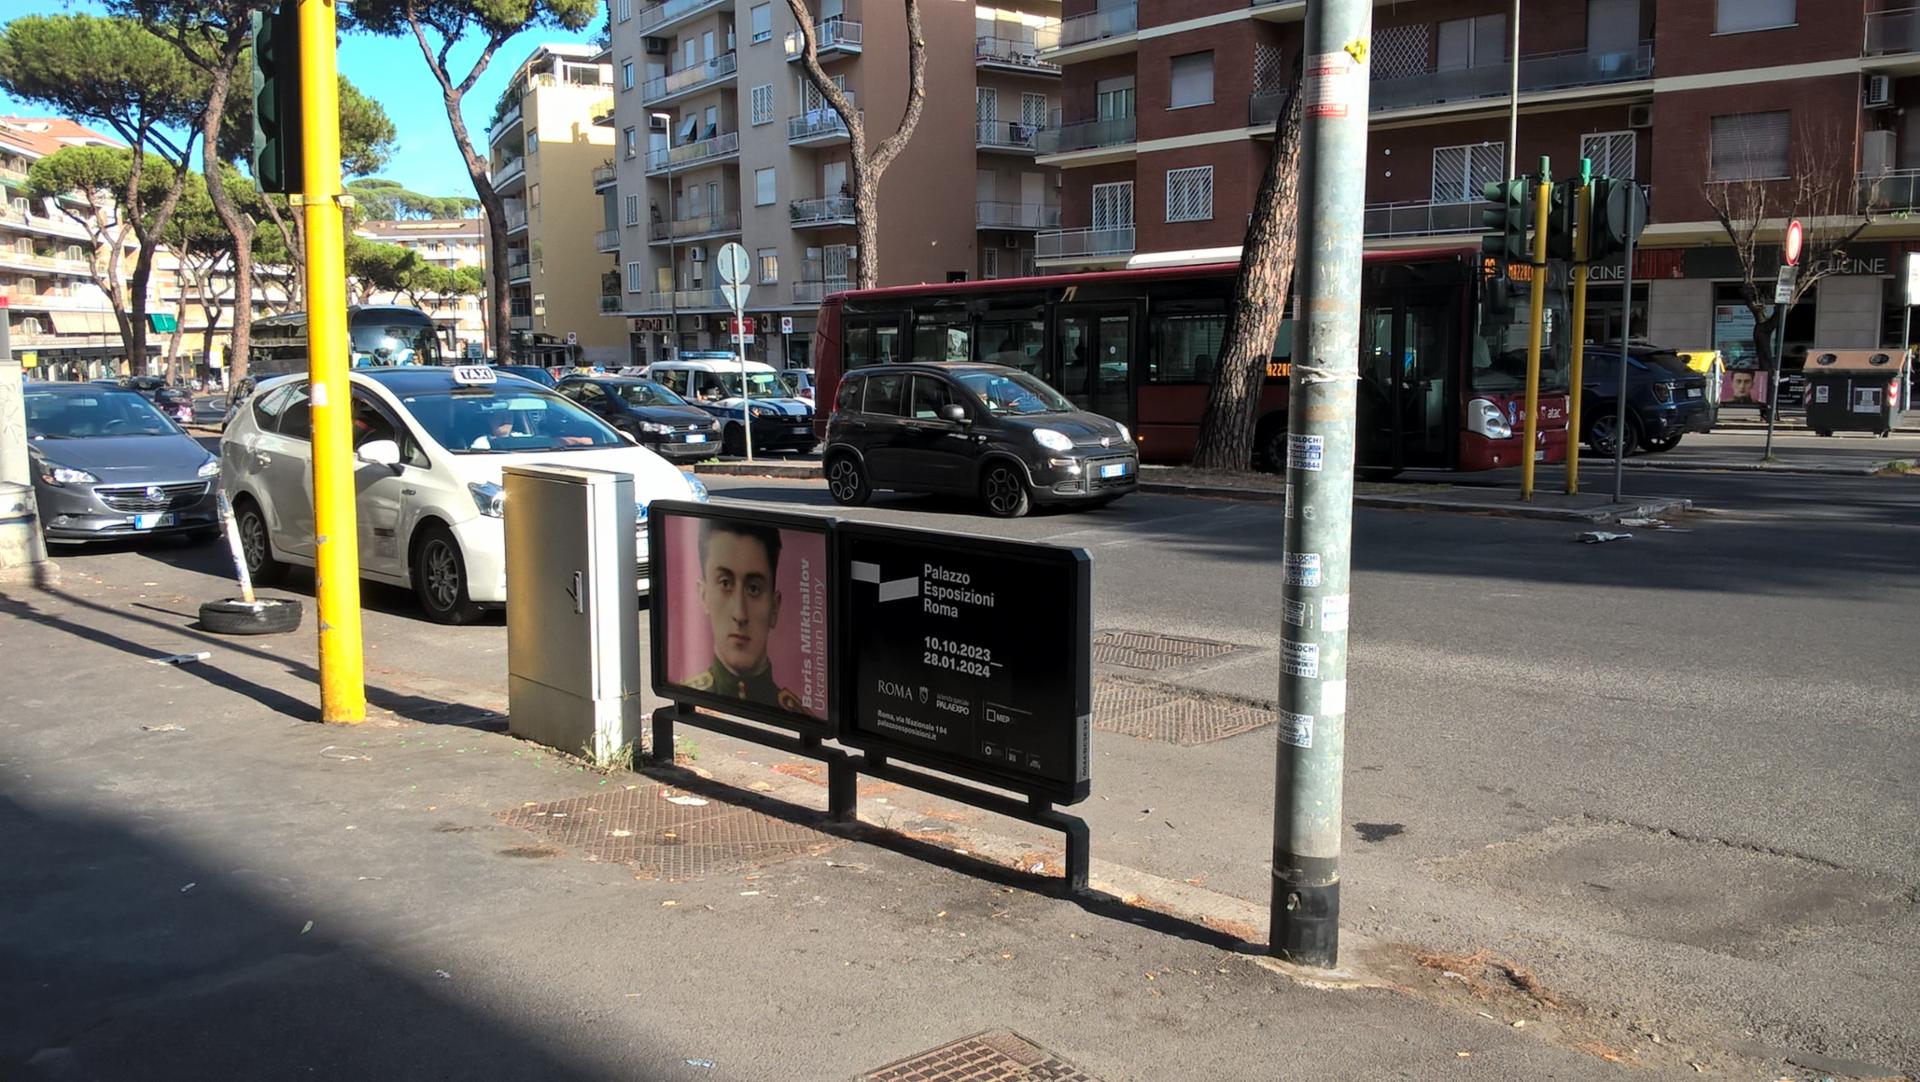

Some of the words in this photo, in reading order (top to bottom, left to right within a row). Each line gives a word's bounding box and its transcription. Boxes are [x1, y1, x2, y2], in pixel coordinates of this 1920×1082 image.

[458, 367, 494, 380] TAXI
[1547, 407, 1561, 419] atac
[924, 563, 970, 585] Palazzo
[800, 558, 812, 654] Mikhailov
[812, 578, 825, 624] Diary
[924, 580, 994, 608] Esposizioni
[924, 597, 958, 618] Roma
[813, 630, 825, 711] Ukrainian
[924, 652, 991, 678] 28.01.2024
[801, 658, 813, 708] Boris
[877, 679, 913, 701] ROMA
